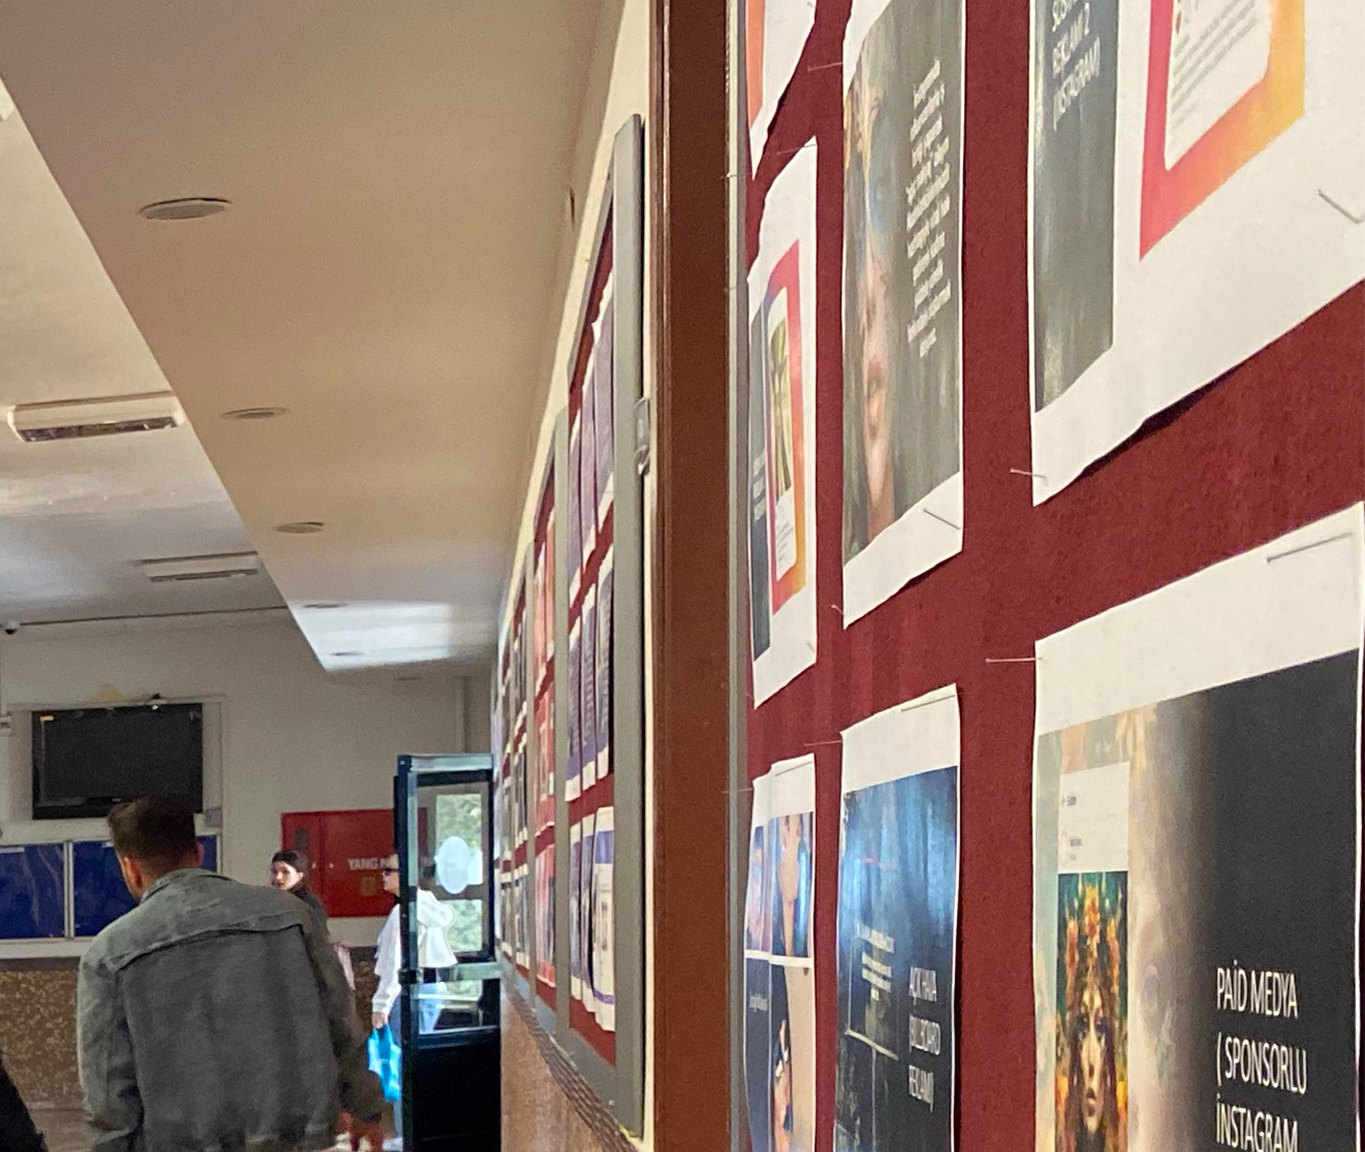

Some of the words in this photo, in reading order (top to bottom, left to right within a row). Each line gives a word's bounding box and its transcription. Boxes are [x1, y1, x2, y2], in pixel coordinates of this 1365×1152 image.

[1217, 959, 1247, 1012] PAİD
[1250, 969, 1298, 1020] MEDYA
[1224, 1036, 1308, 1095] SPONSORLU
